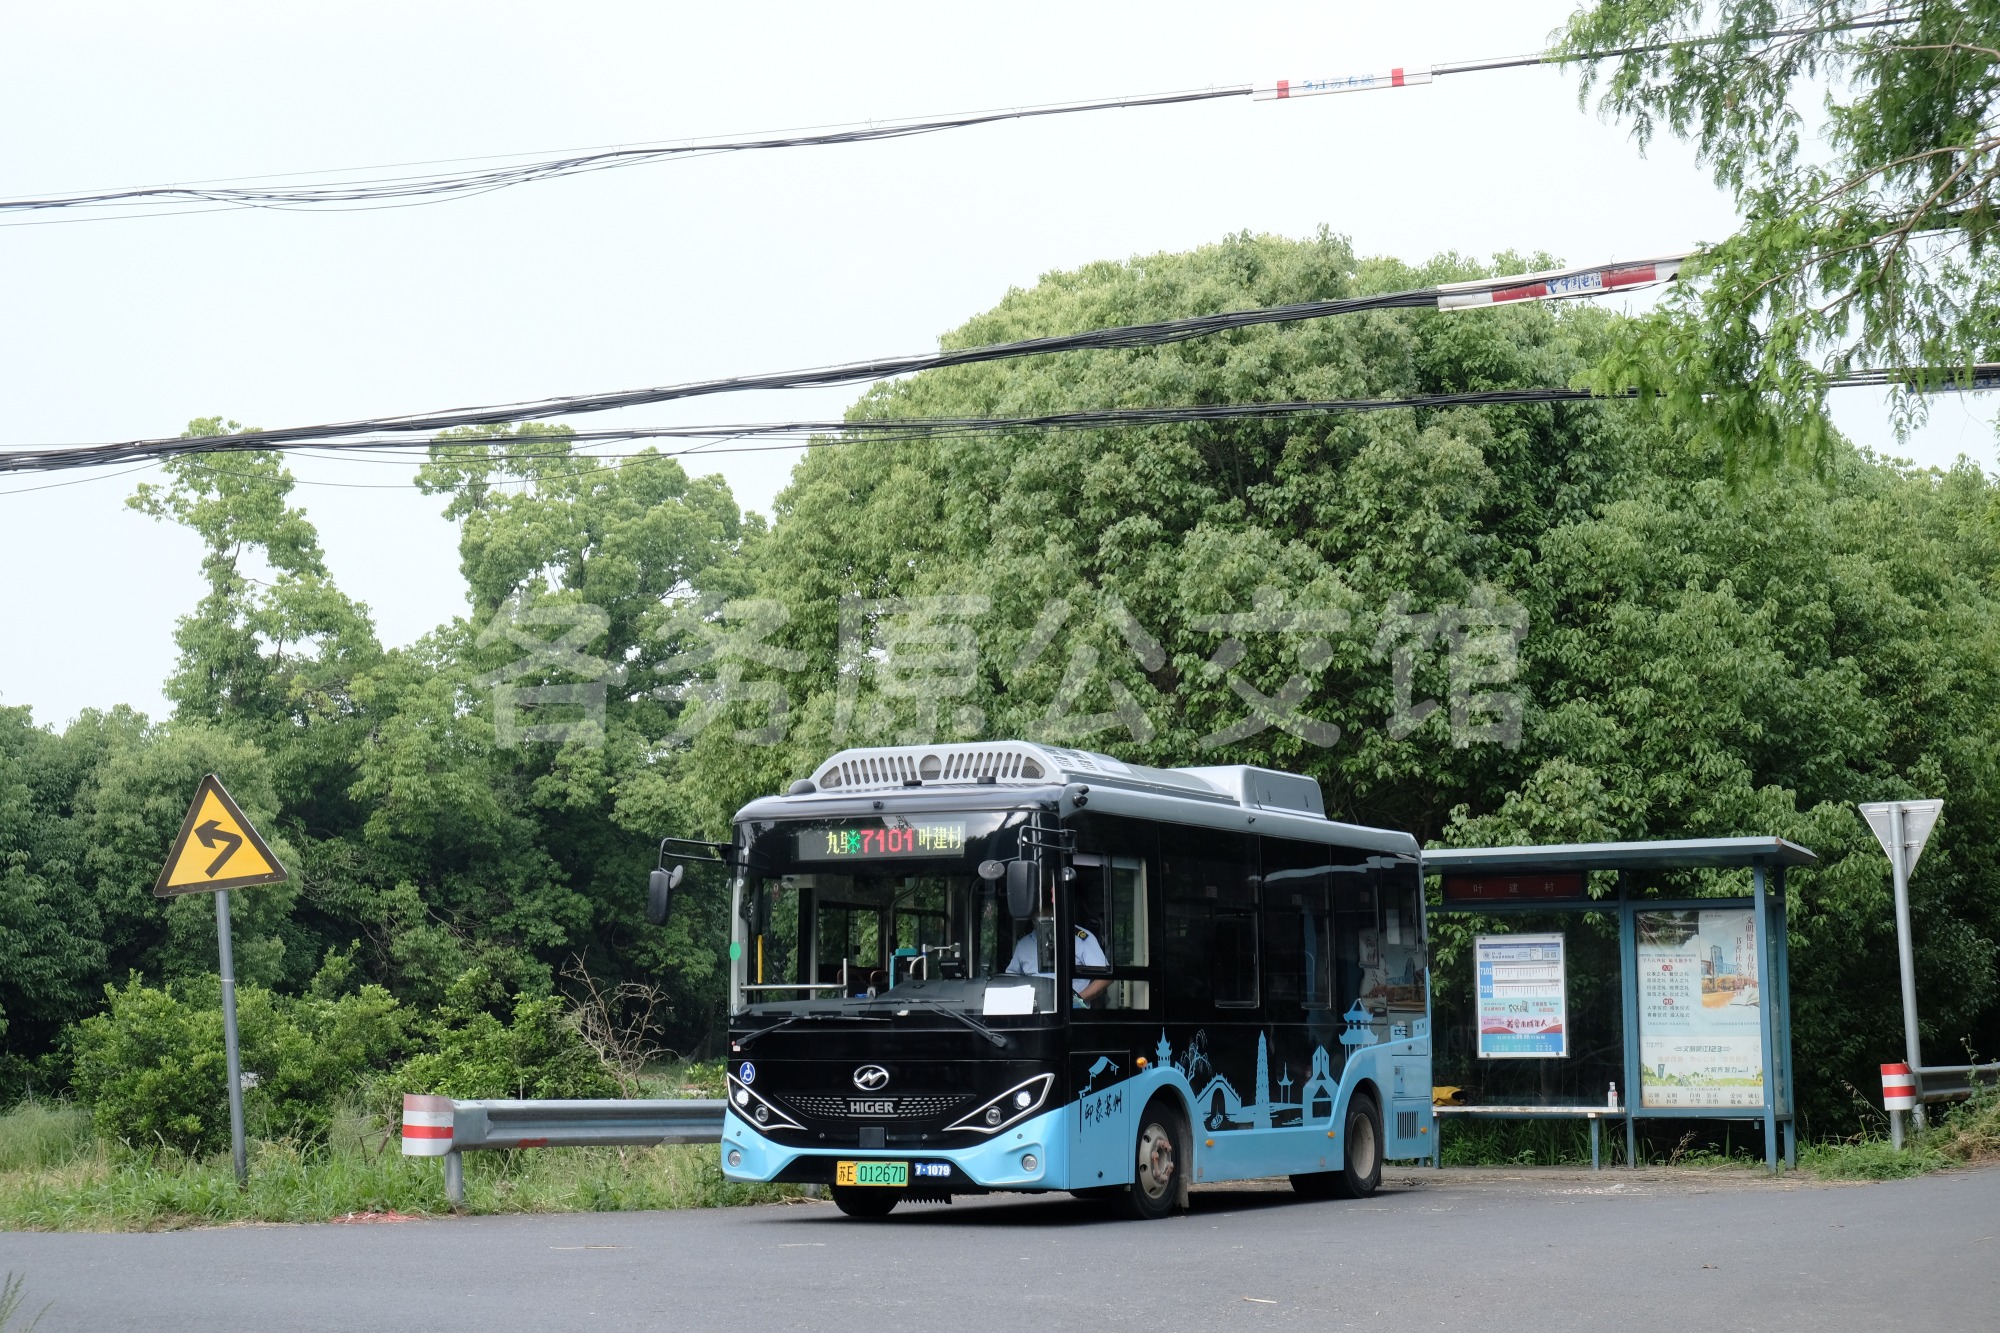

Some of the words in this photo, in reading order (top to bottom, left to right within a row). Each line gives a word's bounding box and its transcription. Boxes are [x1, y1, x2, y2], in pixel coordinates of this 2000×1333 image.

[1560, 273, 1601, 291] 中国电信
[861, 828, 913, 853] 7101
[918, 826, 961, 850] 叶建村
[1473, 881, 1554, 894] 叶建村
[1480, 967, 1492, 975] 7101
[850, 1101, 894, 1114] HIGER
